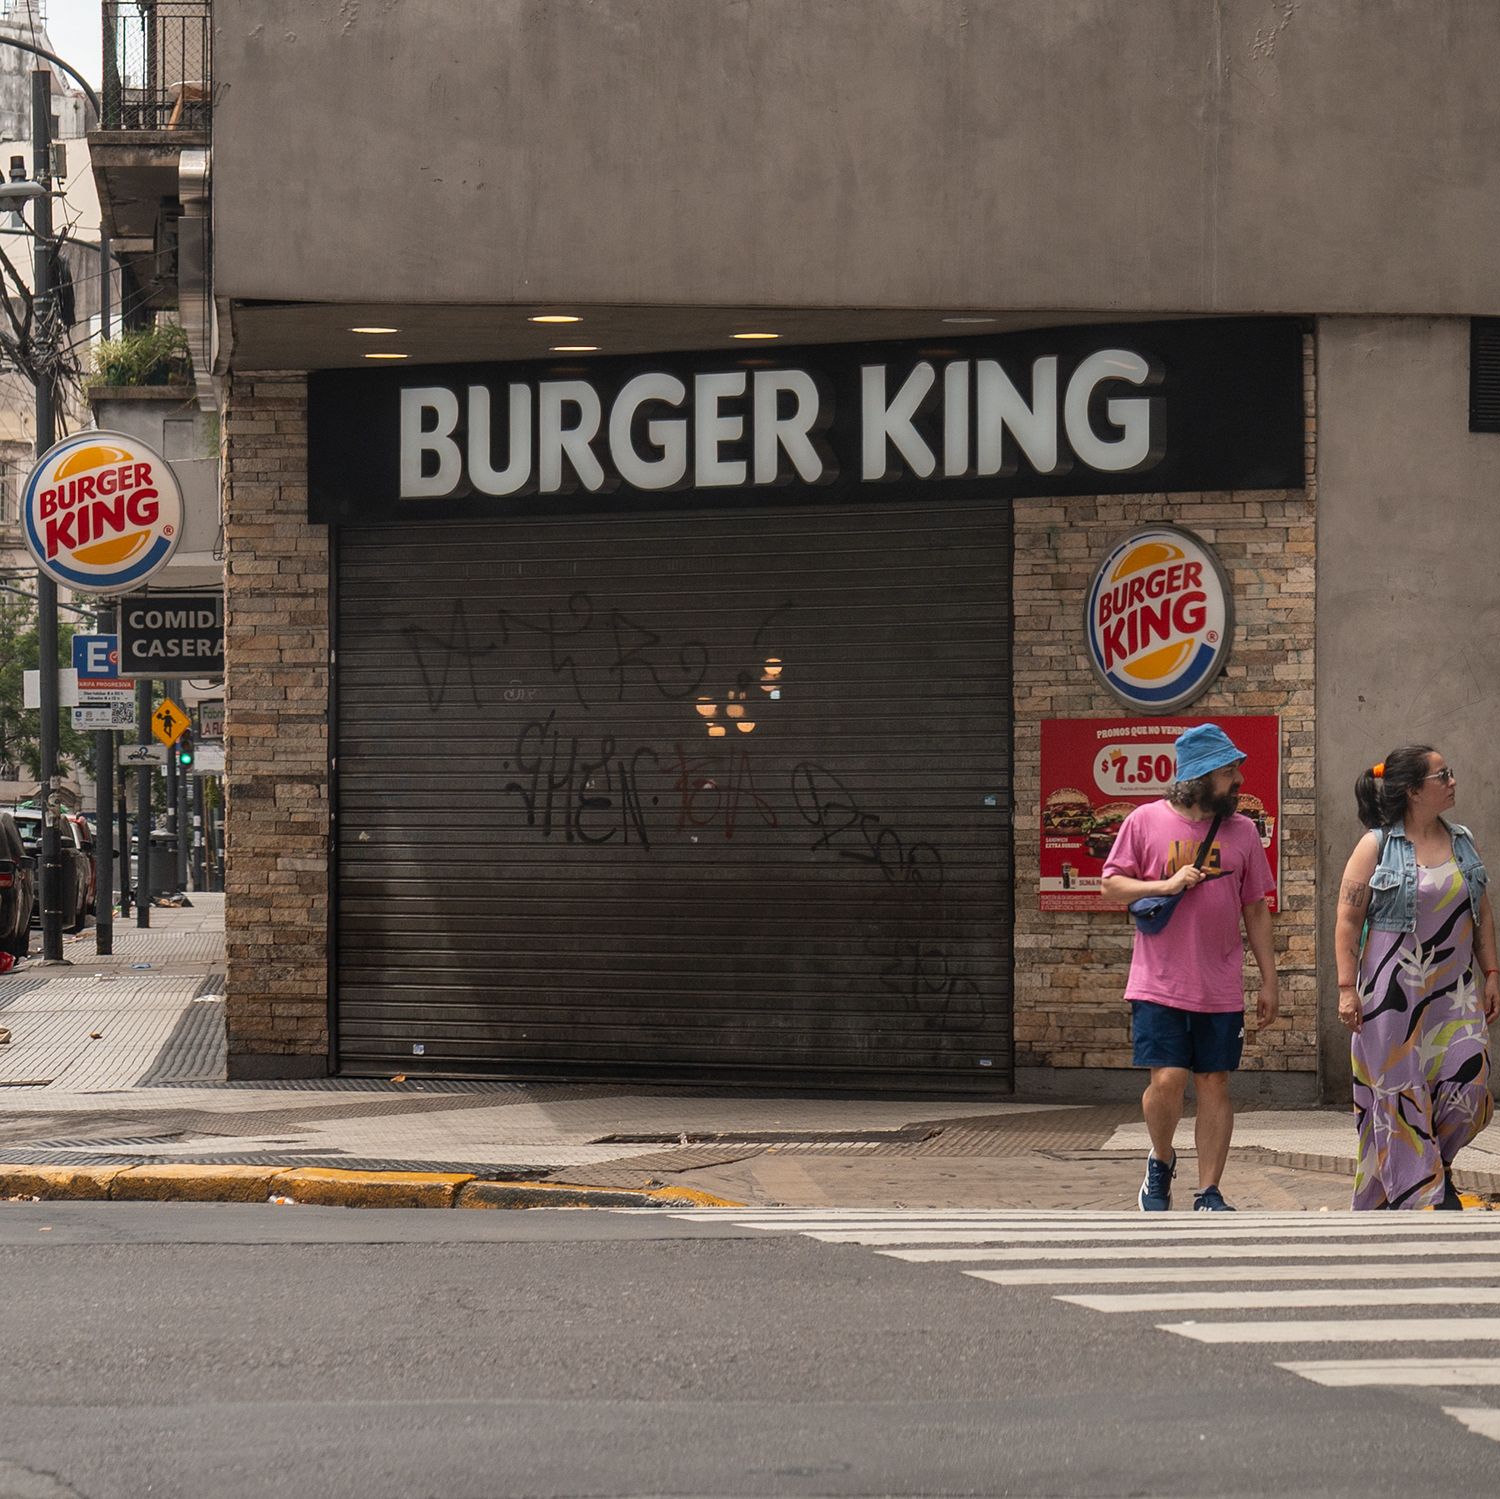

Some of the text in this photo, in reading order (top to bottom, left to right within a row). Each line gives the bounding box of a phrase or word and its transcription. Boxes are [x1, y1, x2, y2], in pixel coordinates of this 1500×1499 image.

[399, 349, 1151, 500] BURGER KING
[40, 463, 153, 521] BURGER
[46, 488, 159, 559] KING
[129, 611, 220, 629] COMID
[1099, 561, 1203, 628] BURGER
[87, 641, 109, 673] E
[1102, 590, 1208, 671] KING
[1096, 727, 1130, 739] PROMOS
[1131, 726, 1147, 737] QUE
[1148, 725, 1160, 735] NO
